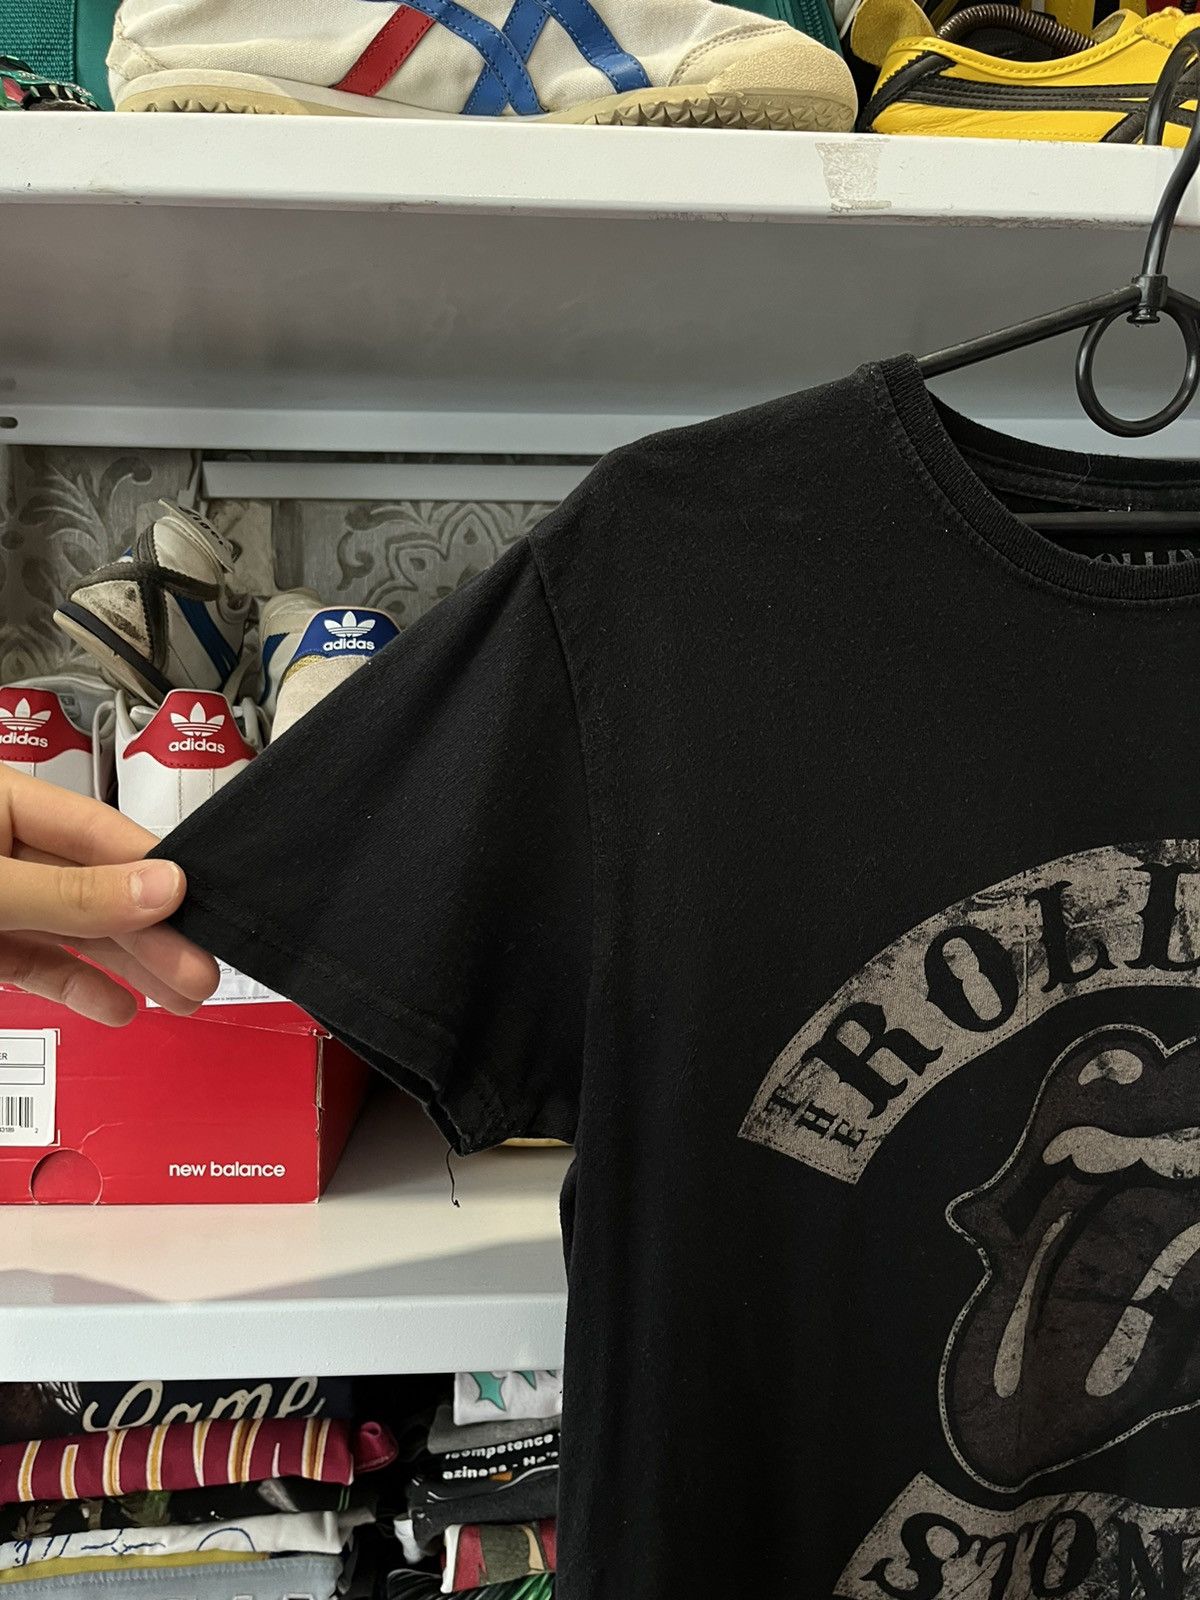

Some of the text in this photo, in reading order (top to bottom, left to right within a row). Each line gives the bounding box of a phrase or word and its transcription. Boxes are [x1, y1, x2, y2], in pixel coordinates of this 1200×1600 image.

[323, 637, 375, 651] adidas
[168, 737, 225, 755] adidas
[763, 1084, 868, 1152] THE
[169, 1161, 286, 1177] new balance
